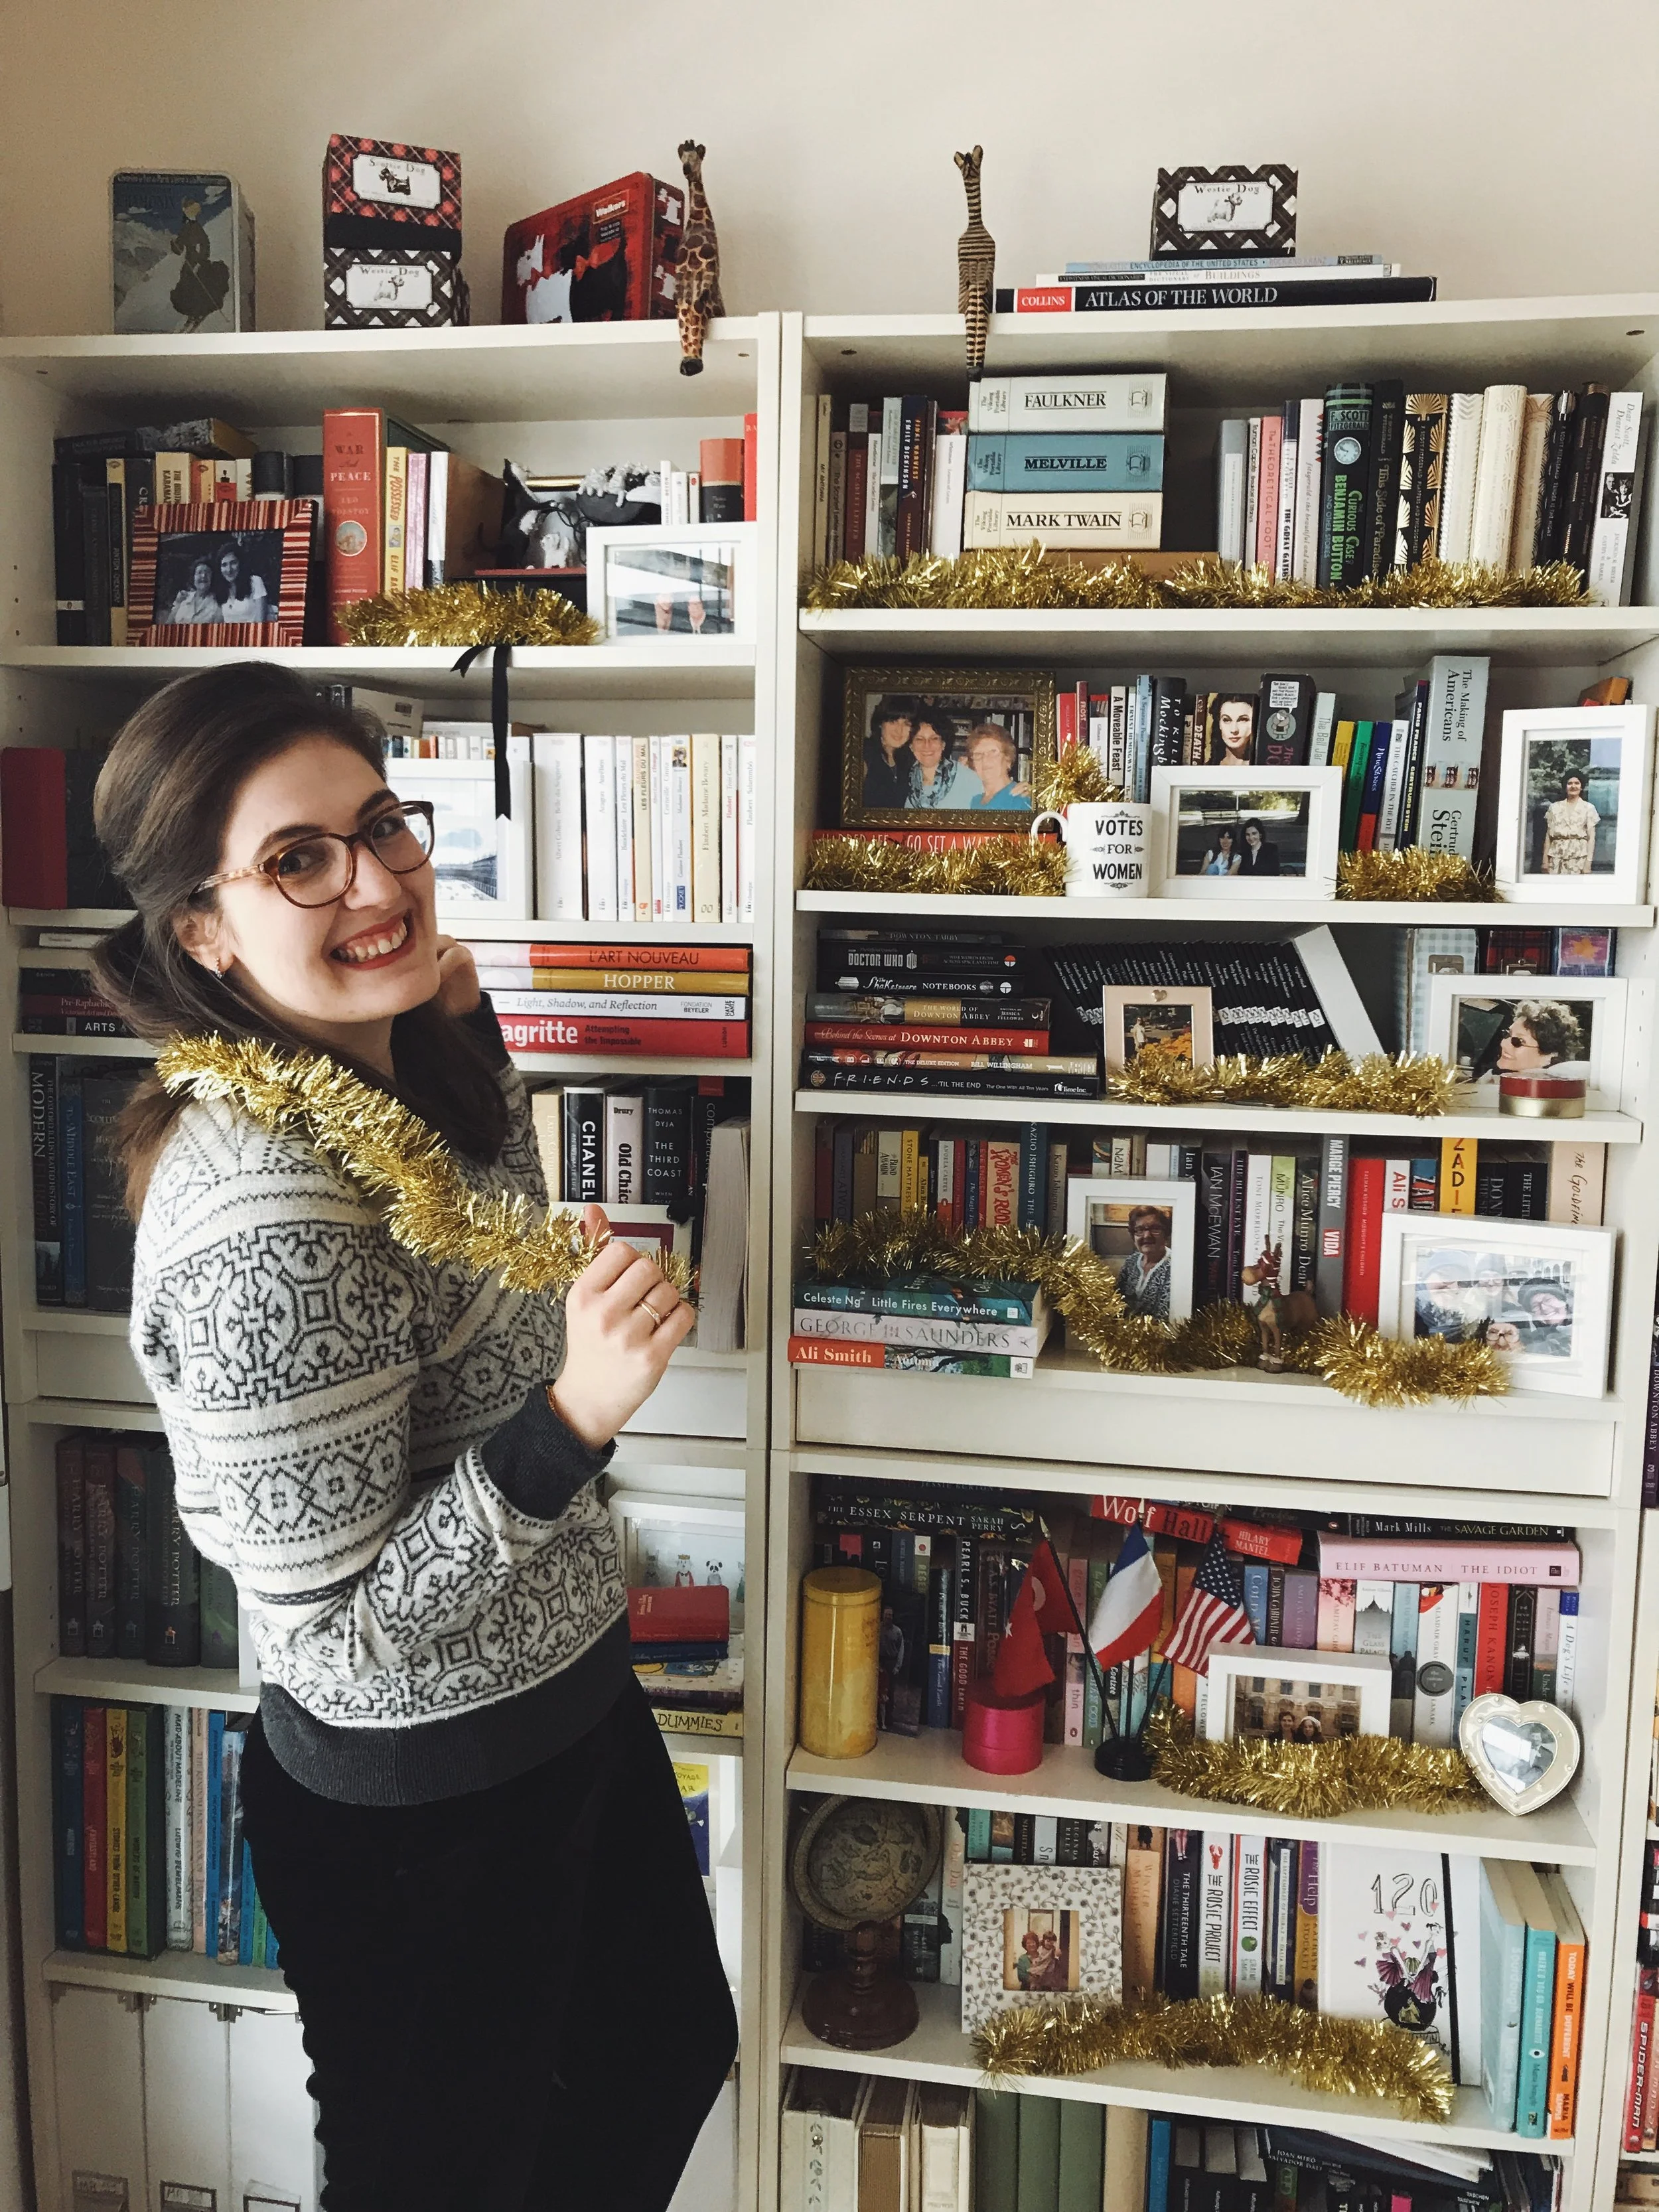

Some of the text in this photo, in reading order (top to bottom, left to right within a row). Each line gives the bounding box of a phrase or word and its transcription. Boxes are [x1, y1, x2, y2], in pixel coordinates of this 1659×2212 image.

[1194, 184, 1260, 194] Westie Dog
[399, 267, 421, 277] Dog
[1129, 261, 1180, 270] ENCYCLOPEDIA
[1204, 270, 1261, 280] BUILDINGS
[1021, 295, 1066, 307] COLLINS
[1085, 287, 1278, 308] ATLAS OF THE WORLD
[1025, 393, 1107, 408] FAULKNER
[1331, 410, 1369, 421] F. SCOTT
[1330, 421, 1369, 431] FITZGERALD
[1623, 403, 1635, 448] Dear Scott,
[1611, 409, 1625, 465] Dearest Zelda
[334, 445, 365, 455] WAR
[902, 445, 911, 490] DICKINSON
[1024, 458, 1108, 469] MELVILLE
[330, 472, 372, 482] PEACE
[1264, 441, 1275, 516] THEORETICAL
[1006, 514, 1121, 527] MARK TWAIN
[1330, 475, 1348, 581] BENJAMIN BUTTON
[1345, 490, 1362, 560] CURIOUS CASE
[1372, 465, 1389, 575] This Side of Paradise
[1442, 669, 1460, 741] Americans
[1456, 669, 1473, 741] The Making of
[1113, 704, 1122, 743] Moveable
[1314, 717, 1331, 761] The Bell Jar
[1411, 729, 1419, 761] FRANCE
[1112, 745, 1121, 772] Feast
[1406, 766, 1415, 808] GERTRUDE
[1095, 820, 1143, 836] VOTES
[1107, 844, 1133, 854] FOR
[1093, 863, 1143, 880] WOMEN
[589, 950, 699, 965] L'ART NOUVEAU
[848, 953, 903, 967] DOCTOR WHO
[603, 974, 675, 990] HOPPER
[922, 982, 977, 991] NOTEBOOKS
[516, 997, 658, 1011] Light, Shadow, and Reflection
[962, 1012, 990, 1021] ABBEY
[84, 1022, 115, 1032] ARTS
[502, 1019, 578, 1047] agritte
[585, 1025, 630, 1035] Attempting
[822, 1026, 851, 1040] Behind
[852, 1029, 864, 1040] the
[865, 1030, 888, 1043] Scenes
[584, 1037, 642, 1047] the Impossible
[901, 1032, 1014, 1047] DOWNTON ABBEY
[31, 1071, 46, 1158] MODERN
[648, 1107, 683, 1116] THOMAS
[655, 1142, 674, 1150] THE
[582, 1120, 596, 1201] CHANEL
[618, 1143, 632, 1167] Old
[649, 1155, 680, 1164] THIRD
[1327, 1139, 1344, 1209] MARGE PIERCY
[1275, 1173, 1285, 1213] MUNRO
[1207, 1165, 1224, 1258] IAN McEWAN
[1297, 1174, 1315, 1286] Alice Munro Dear
[1323, 1230, 1340, 1256] VIDA
[804, 1292, 997, 1317] Celeste Ng Little Fires Everywhere
[800, 1317, 1009, 1348] GEORGE SAUNDERS
[796, 1346, 871, 1364] Ali Smith
[849, 1506, 892, 1520] ESSEX
[900, 1510, 966, 1526] SERPENT
[970, 1515, 1004, 1525] SARAH
[972, 1522, 1003, 1532] PERRY
[1375, 1522, 1549, 1536] Mark Mills SAVAGE GARDEN
[1238, 1530, 1271, 1546] HILARY
[1235, 1540, 1270, 1556] MANTEL
[1336, 1562, 1538, 1576] ELIF BATUMAN THE IDIOT
[960, 1540, 972, 1619] PEARL S. BUCK
[1108, 1664, 1119, 1696] Coetzee
[657, 1714, 723, 1730] DUMMIES
[1245, 1854, 1260, 1866] THE
[1182, 1872, 1190, 1889] THE
[1208, 1874, 1223, 1887] THE
[1370, 1873, 1438, 1917] 120
[1181, 1891, 1190, 1946] THIRTEENTH
[1241, 1900, 1259, 1931] EFFECT
[1204, 1923, 1222, 1963] PROJECT
[1632, 2021, 1648, 2128] SPIDER-MAN
